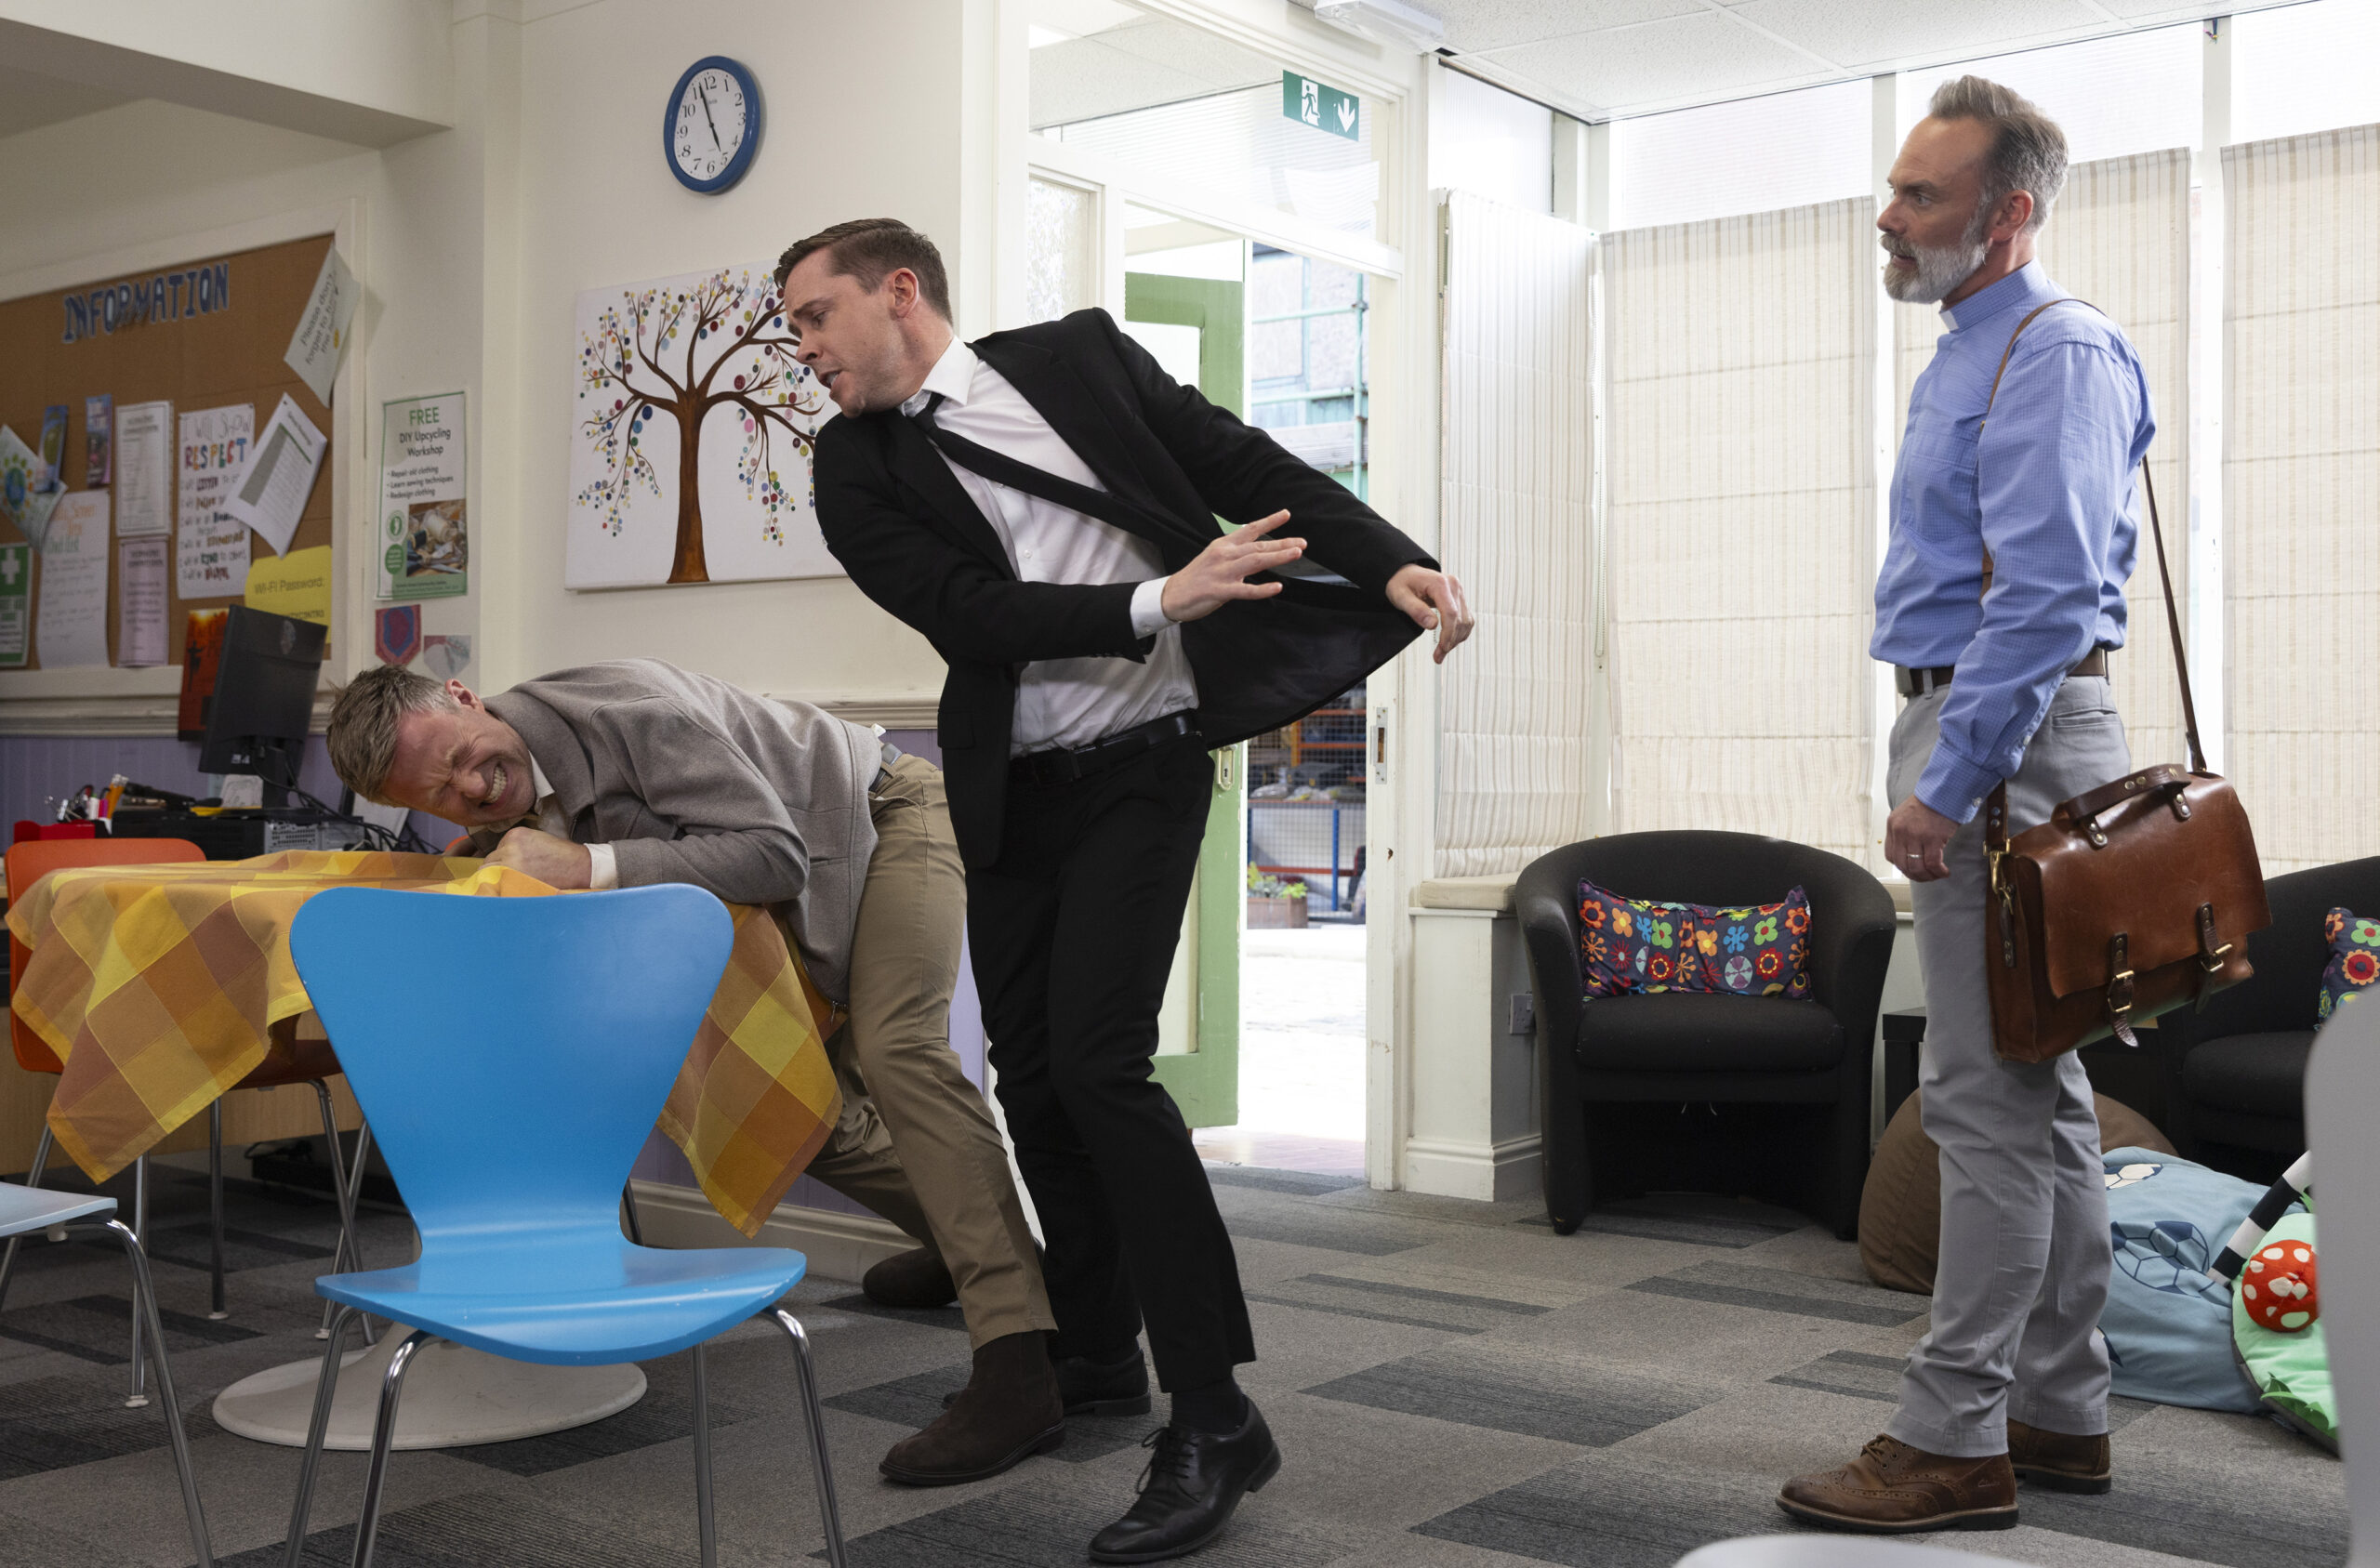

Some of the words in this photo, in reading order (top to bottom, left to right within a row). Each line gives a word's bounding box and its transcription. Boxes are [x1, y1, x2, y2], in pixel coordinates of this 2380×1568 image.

[704, 75, 717, 90] 12
[724, 79, 729, 92] 1
[734, 93, 743, 107] 2
[682, 103, 695, 118] 10
[737, 112, 746, 125] 3
[680, 125, 688, 138] 9
[732, 135, 740, 147] 4
[681, 144, 691, 157] 8
[694, 157, 702, 170] 7
[721, 152, 728, 165] 5
[707, 161, 715, 174] 6
[62, 261, 230, 344] INFORMATION
[299, 306, 321, 347] Please
[409, 406, 440, 427] FREE
[399, 431, 413, 444] DIY
[415, 428, 452, 443] Upcycling
[185, 437, 247, 470] RESPECT
[407, 444, 443, 457] Workshop
[418, 467, 439, 475] clothing
[425, 476, 454, 485] techniques
[415, 488, 436, 497] clothing
